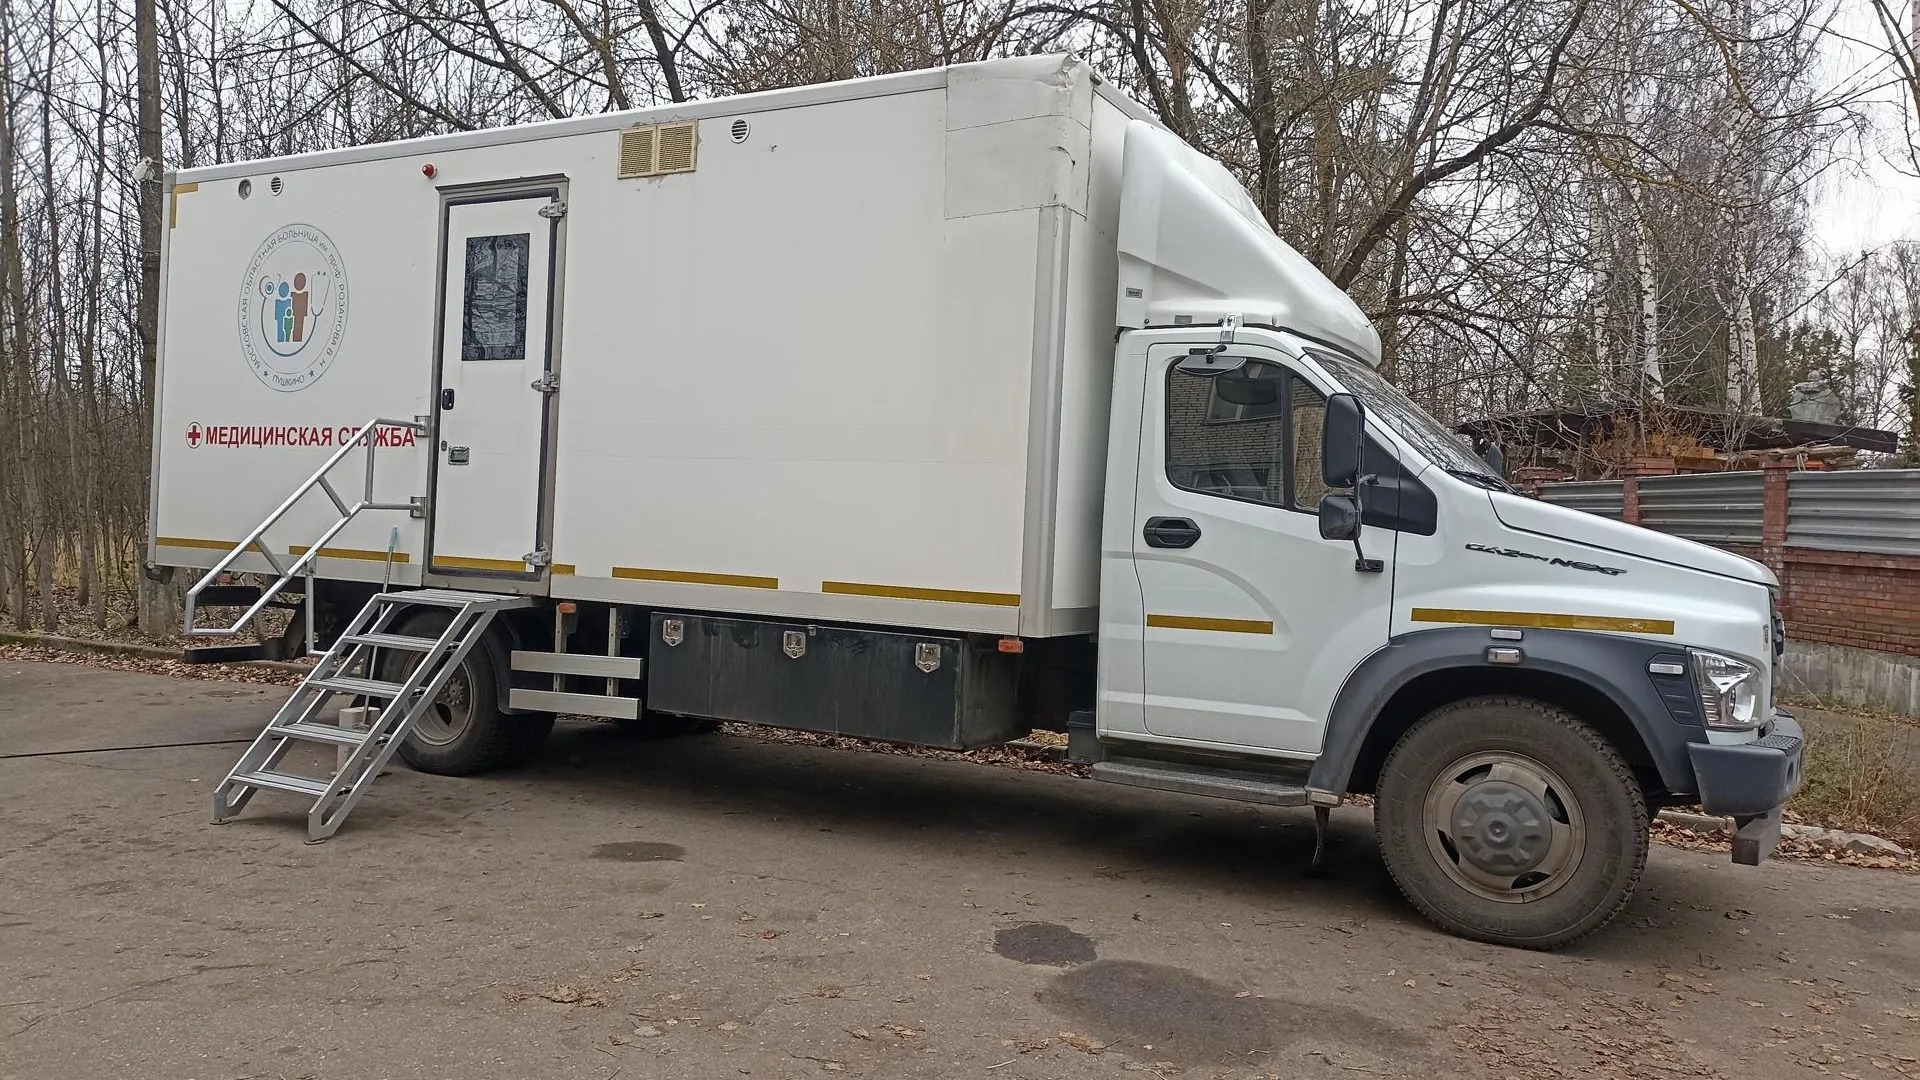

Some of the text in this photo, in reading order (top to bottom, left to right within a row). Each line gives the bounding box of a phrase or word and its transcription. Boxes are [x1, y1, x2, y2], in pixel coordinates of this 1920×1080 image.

[277, 229, 319, 244] БОЛЬНИЦА
[244, 238, 277, 295] ОБЛАСТНАЯ
[331, 284, 346, 346] РОЗАНОВА
[242, 298, 261, 369] МОСКОВСКАЯ
[272, 374, 305, 386] ПУШКИНО
[205, 426, 333, 448] МЕДИЦИНСКАЯ
[1549, 557, 1628, 577] NEXT
